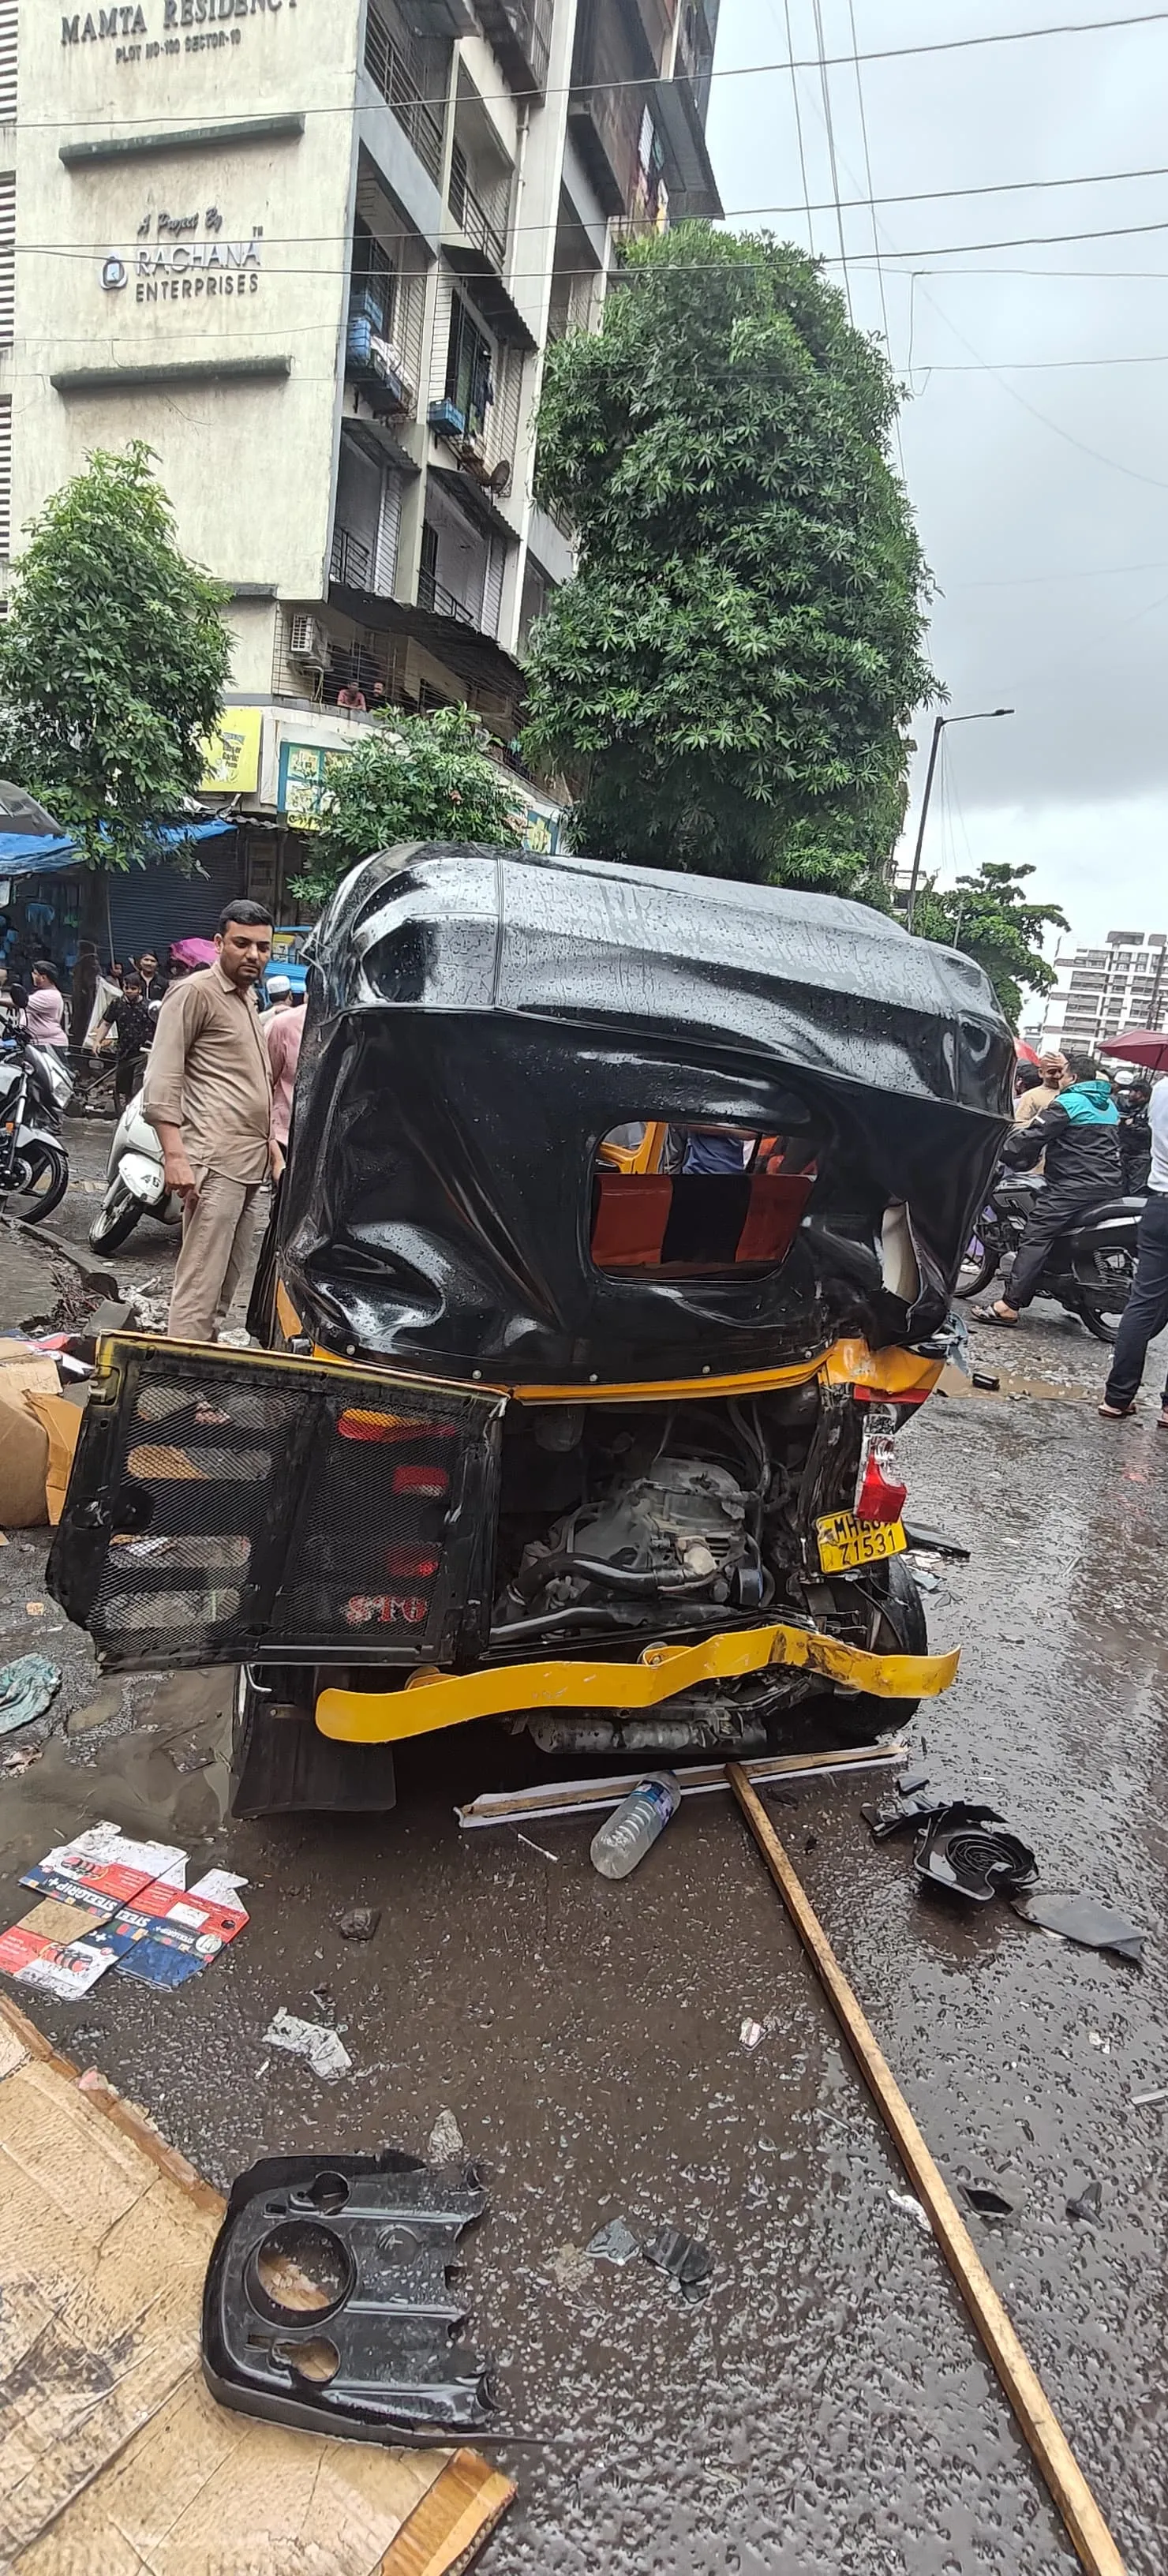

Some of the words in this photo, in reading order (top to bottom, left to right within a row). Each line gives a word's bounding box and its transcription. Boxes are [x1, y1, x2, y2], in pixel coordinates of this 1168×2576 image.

[61, 4, 148, 46] MAMTA
[163, 0, 298, 30] RESIDEN
[116, 44, 141, 65] PLOT
[137, 214, 151, 235] A
[158, 211, 199, 238] Project
[205, 206, 223, 234] By
[136, 241, 260, 276] RACHANA
[136, 273, 259, 303] ENTERPRISES
[839, 1530, 896, 1566] Z1531
